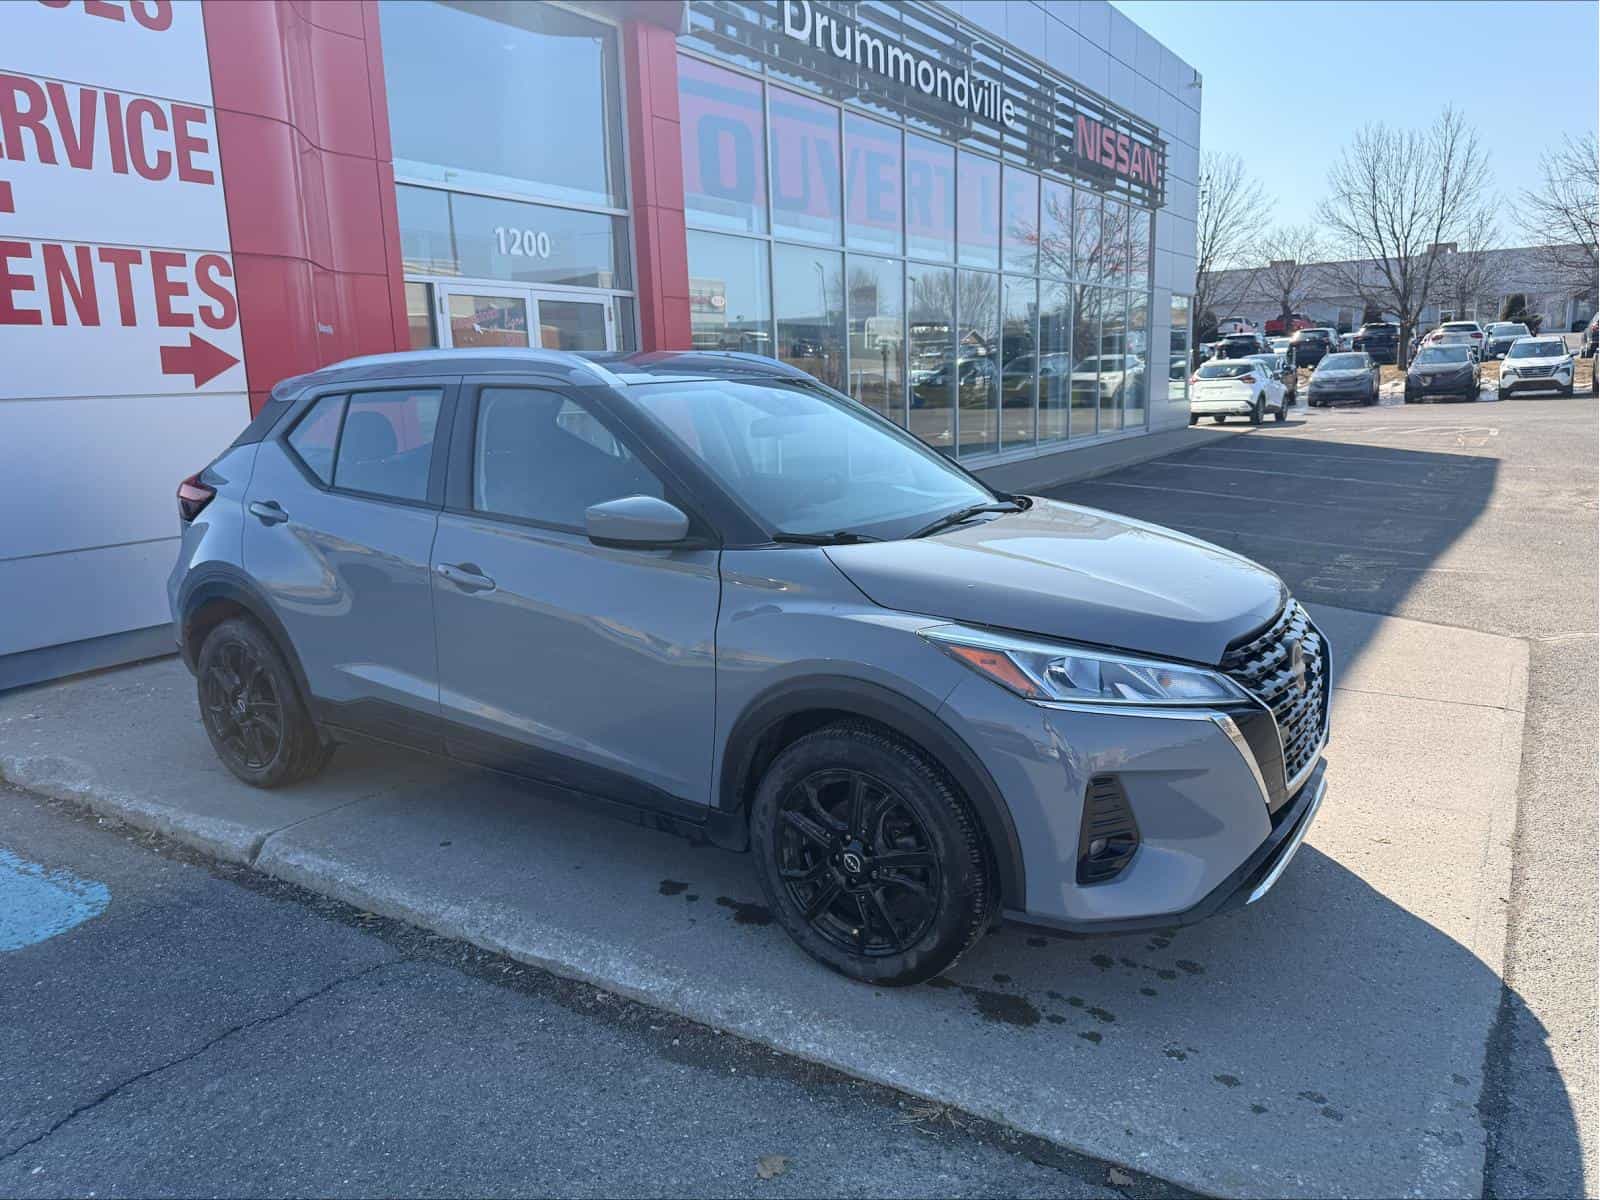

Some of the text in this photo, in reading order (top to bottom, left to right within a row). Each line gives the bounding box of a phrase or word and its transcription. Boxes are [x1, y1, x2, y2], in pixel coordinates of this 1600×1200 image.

[784, 0, 1015, 126] Drummondville
[0, 74, 215, 185] RVICE
[697, 113, 967, 230] OUVERT
[1077, 114, 1158, 189] NISSAN
[494, 226, 551, 259] 1200
